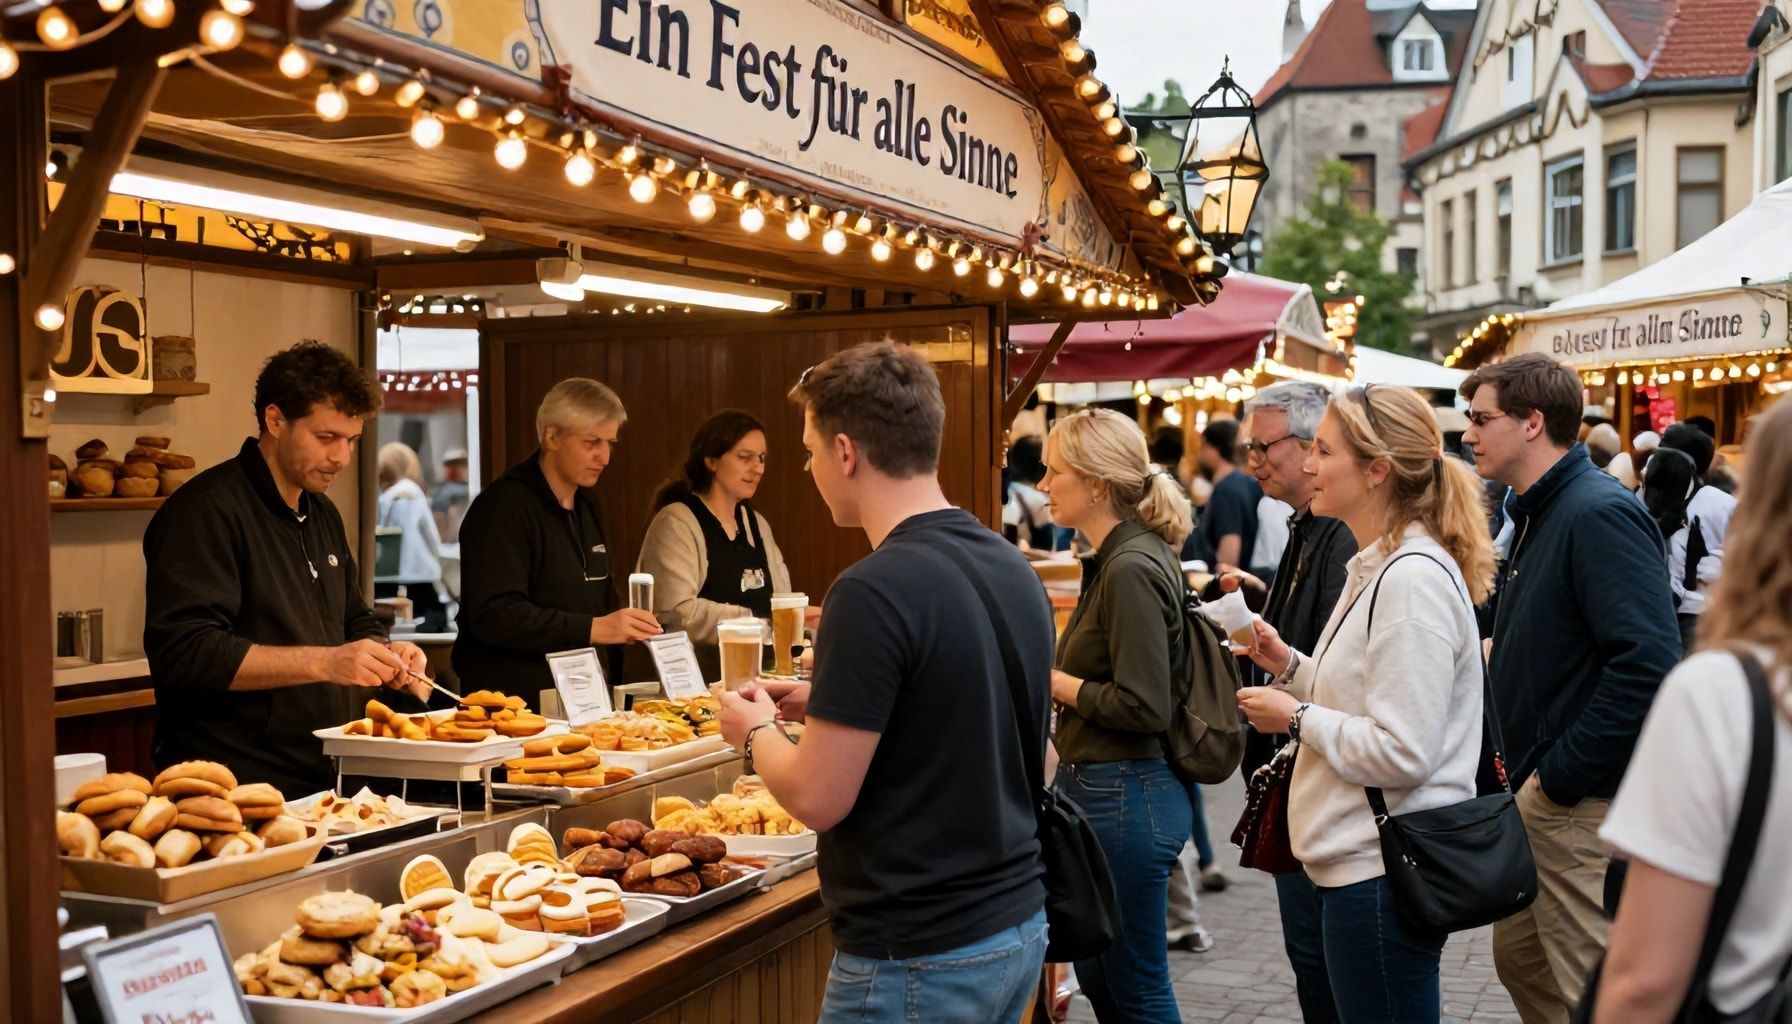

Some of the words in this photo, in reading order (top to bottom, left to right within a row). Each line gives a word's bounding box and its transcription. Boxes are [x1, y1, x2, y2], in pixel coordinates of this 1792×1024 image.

[594, 0, 690, 79] Ein
[706, 0, 802, 119] Fest
[798, 43, 868, 152] für
[874, 79, 931, 167] alle
[940, 104, 1018, 199] Sinne
